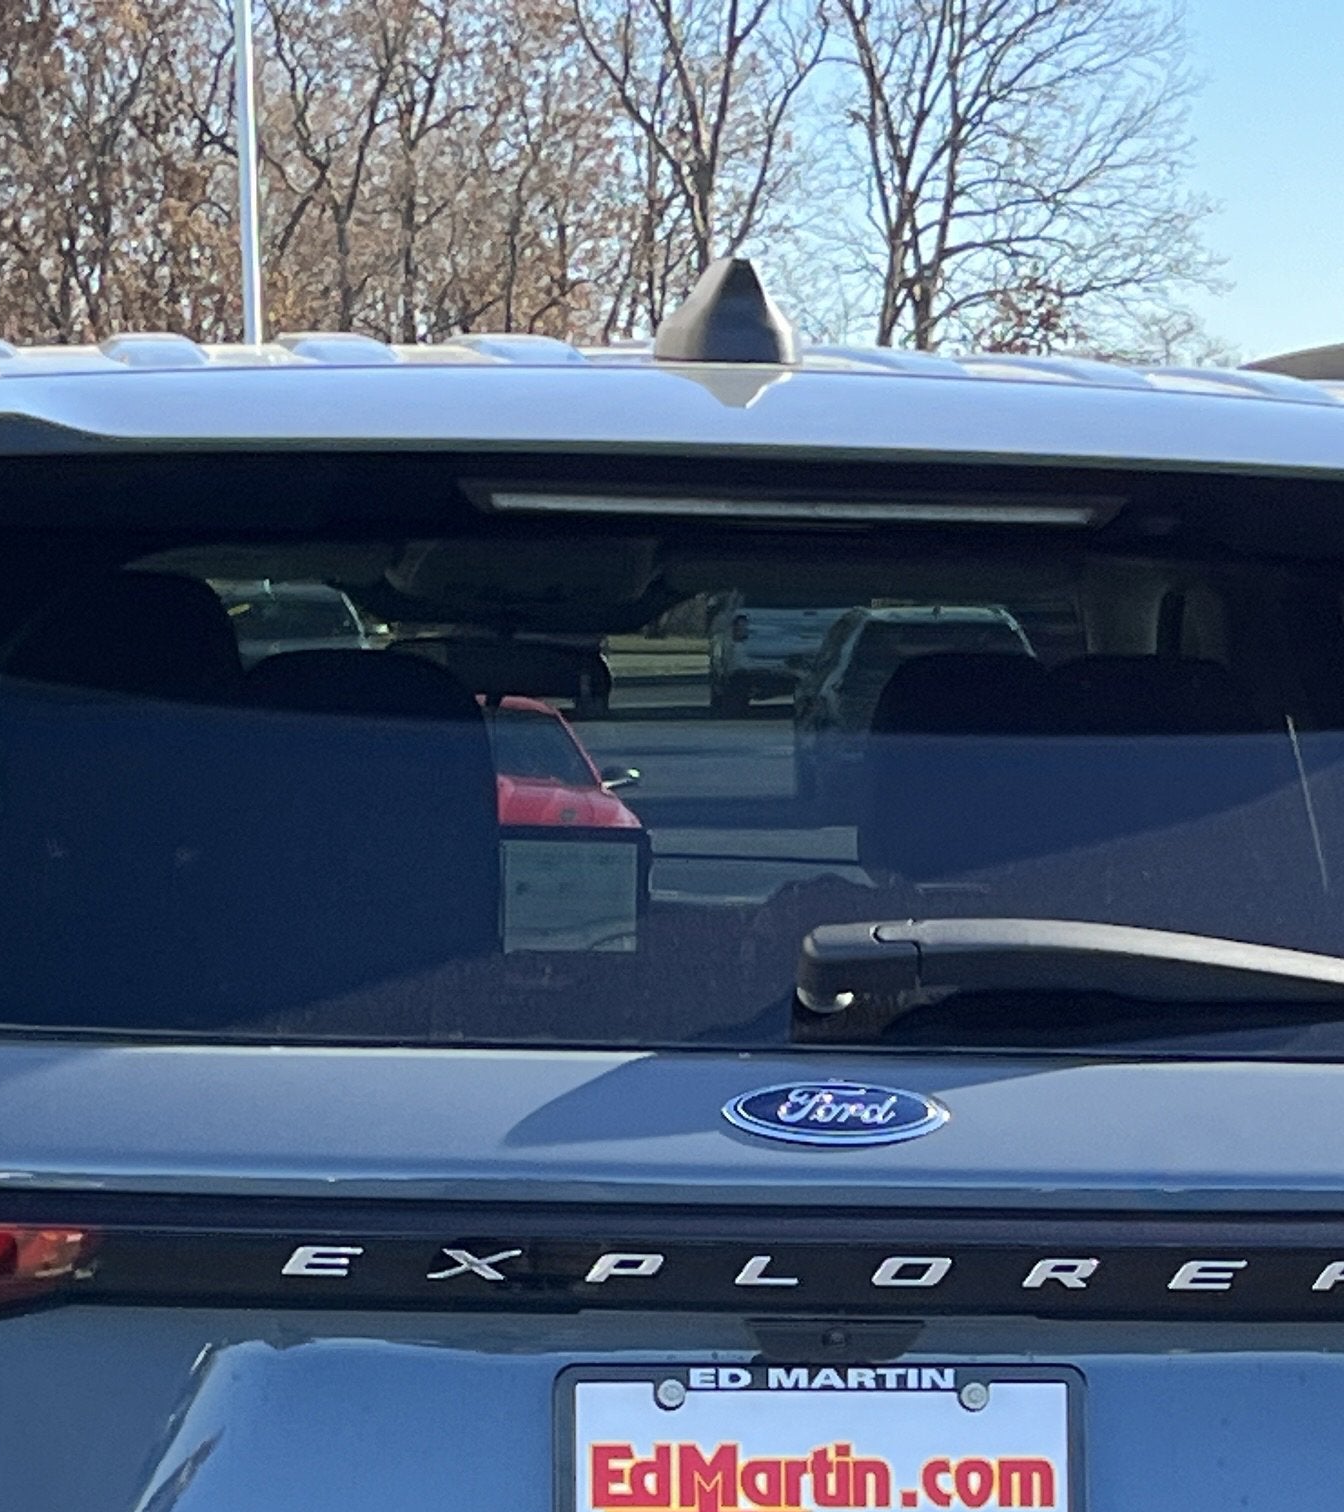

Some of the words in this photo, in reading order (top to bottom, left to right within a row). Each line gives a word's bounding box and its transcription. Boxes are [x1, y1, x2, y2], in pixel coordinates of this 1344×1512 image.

[776, 1086, 898, 1124] Ford
[688, 1367, 752, 1389] ED
[767, 1368, 956, 1390] MARTIN
